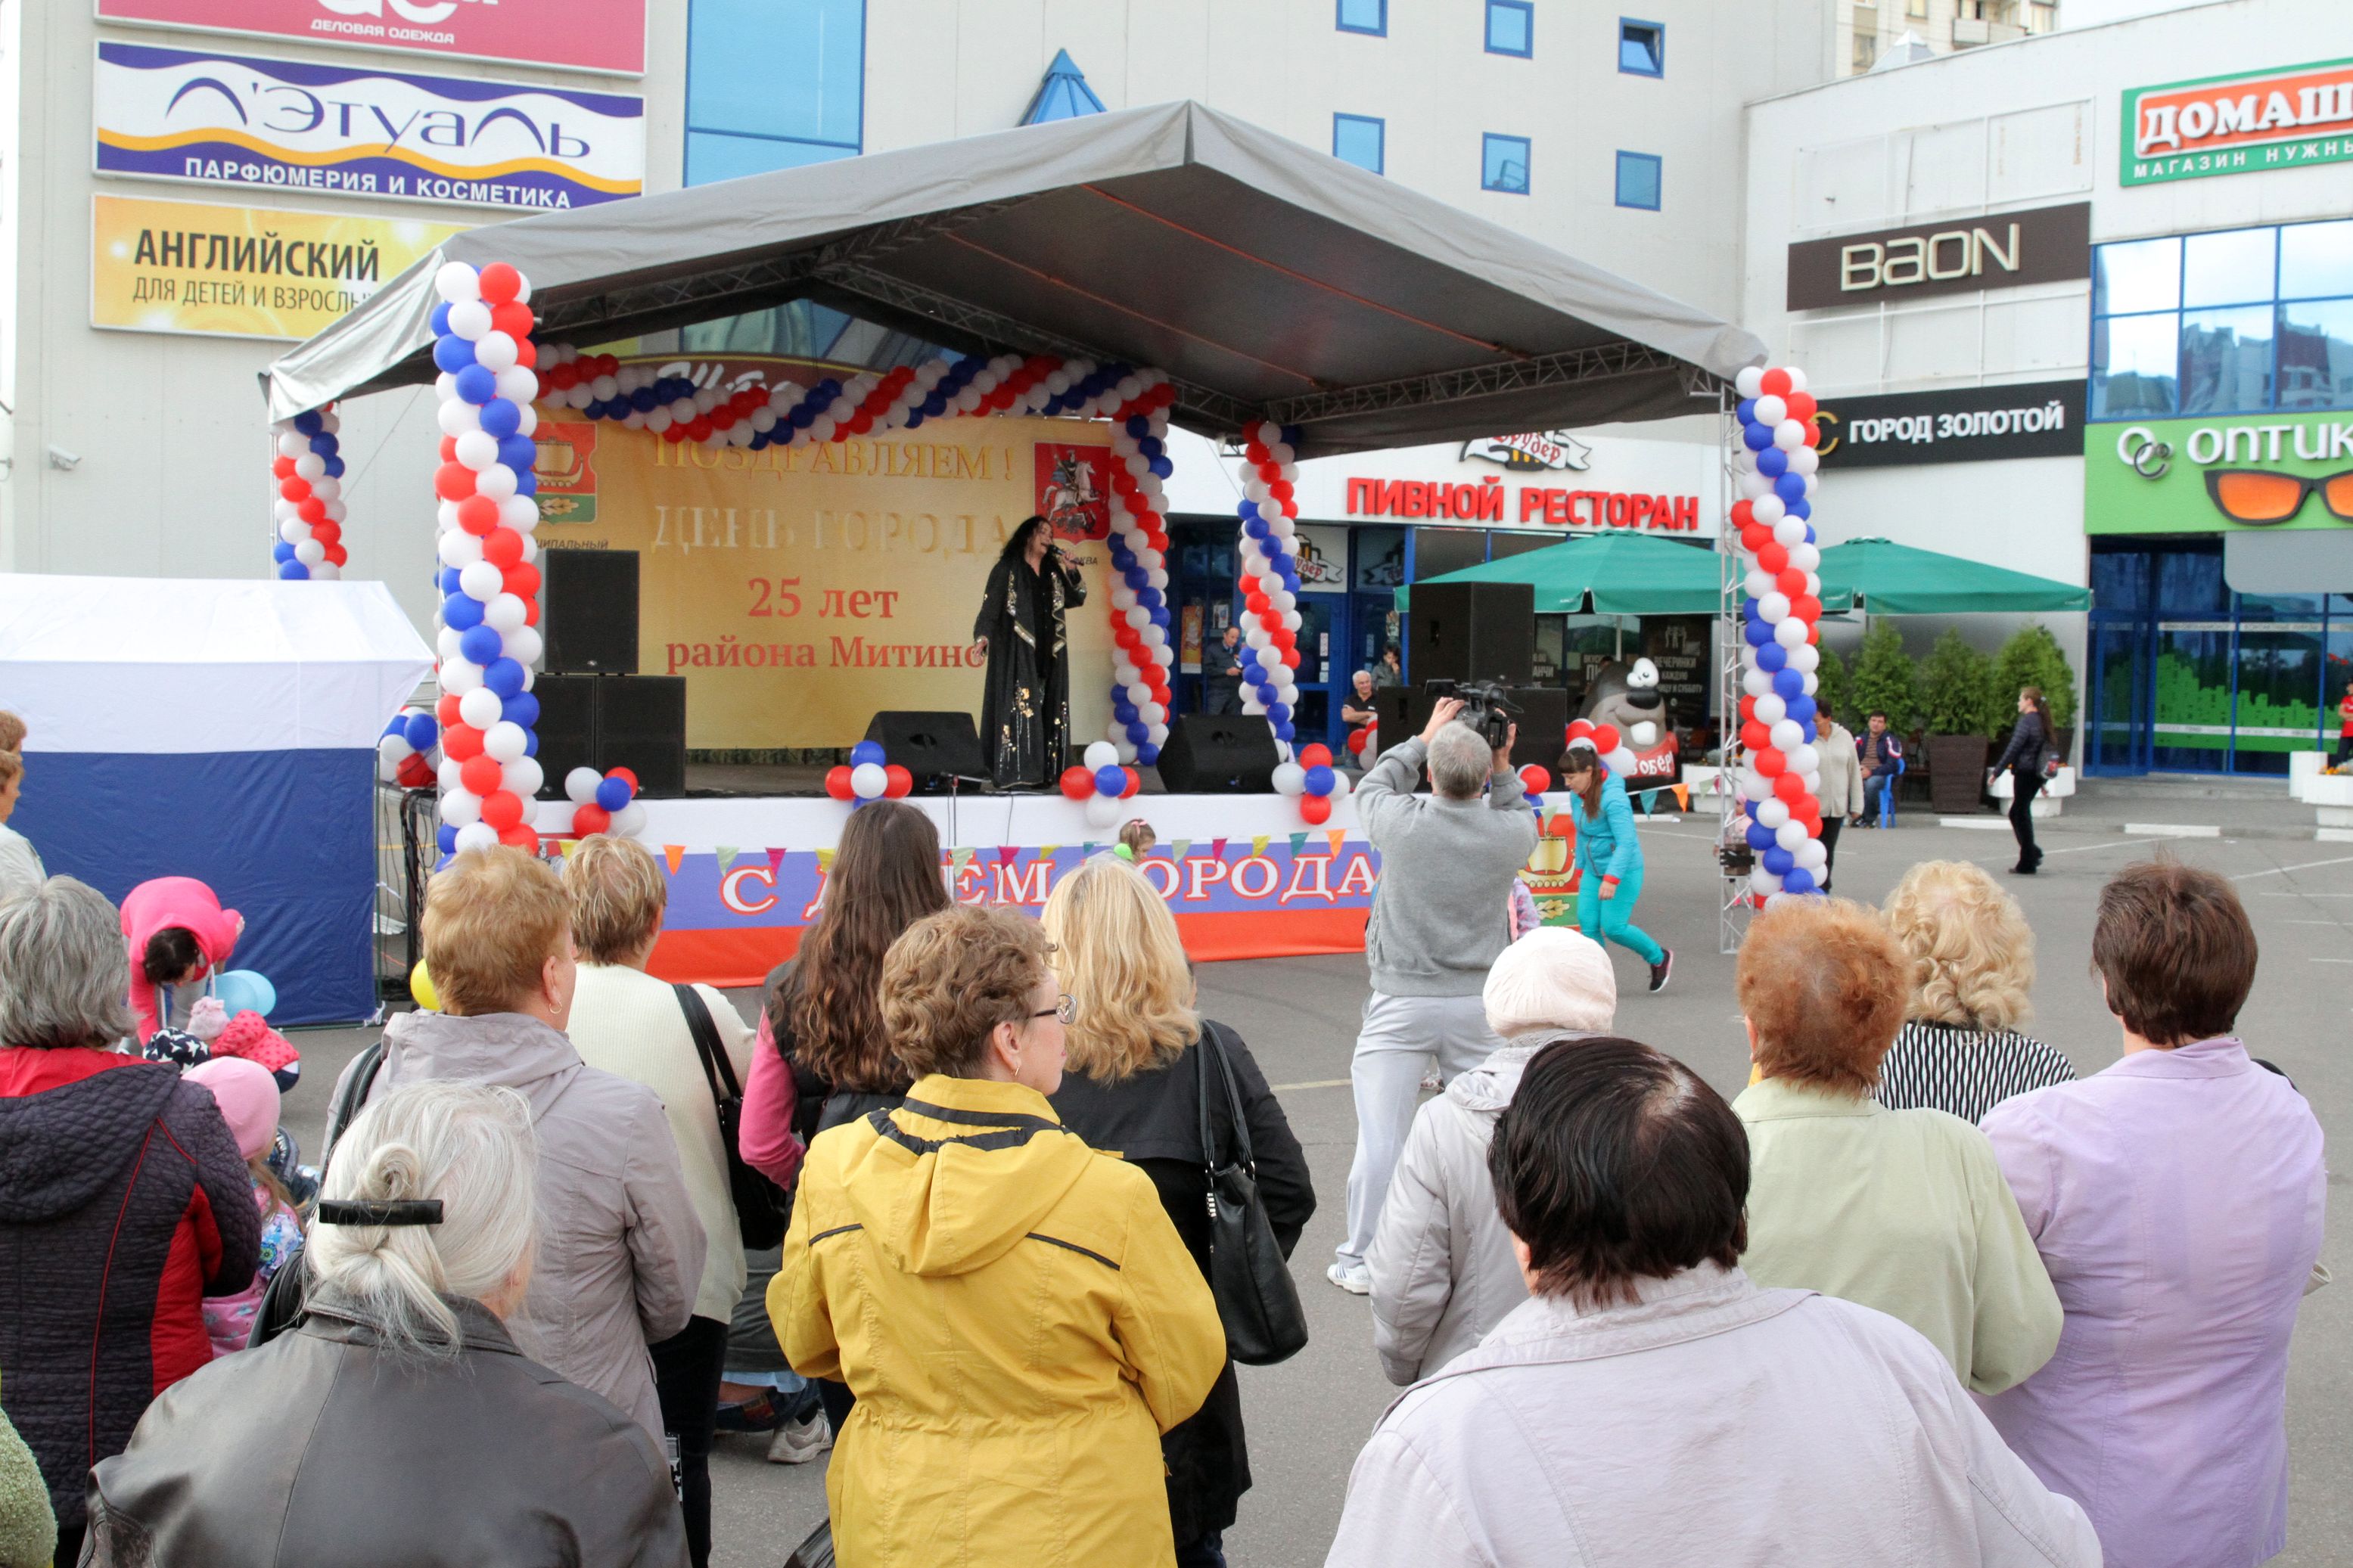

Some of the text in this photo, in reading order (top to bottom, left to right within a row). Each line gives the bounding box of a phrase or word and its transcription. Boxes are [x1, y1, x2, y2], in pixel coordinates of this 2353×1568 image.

[311, 18, 455, 44] ДЕЛОВАЯ ОДЕЖДА
[185, 157, 571, 209] ПАРФЮМЕРИЯ И КОСМЕТИКА
[2134, 151, 2246, 179] МАГАЗИН
[134, 229, 378, 281] АНГЛИЙСКИЙ
[133, 277, 371, 312] ДЛЯ ДЕТЕЙ И ВЗРОСЛ
[1849, 415, 1934, 444] ГОРОД
[1937, 399, 2065, 439] ЗОЛОТОЙ
[1347, 475, 1699, 530] ПИВНОЙ РЕСТОРАН
[651, 505, 794, 555] ДЕНЬ
[748, 576, 899, 619] 25 лет
[665, 634, 816, 675] района
[720, 866, 778, 915] С
[1135, 853, 1379, 906] ОРОДА
